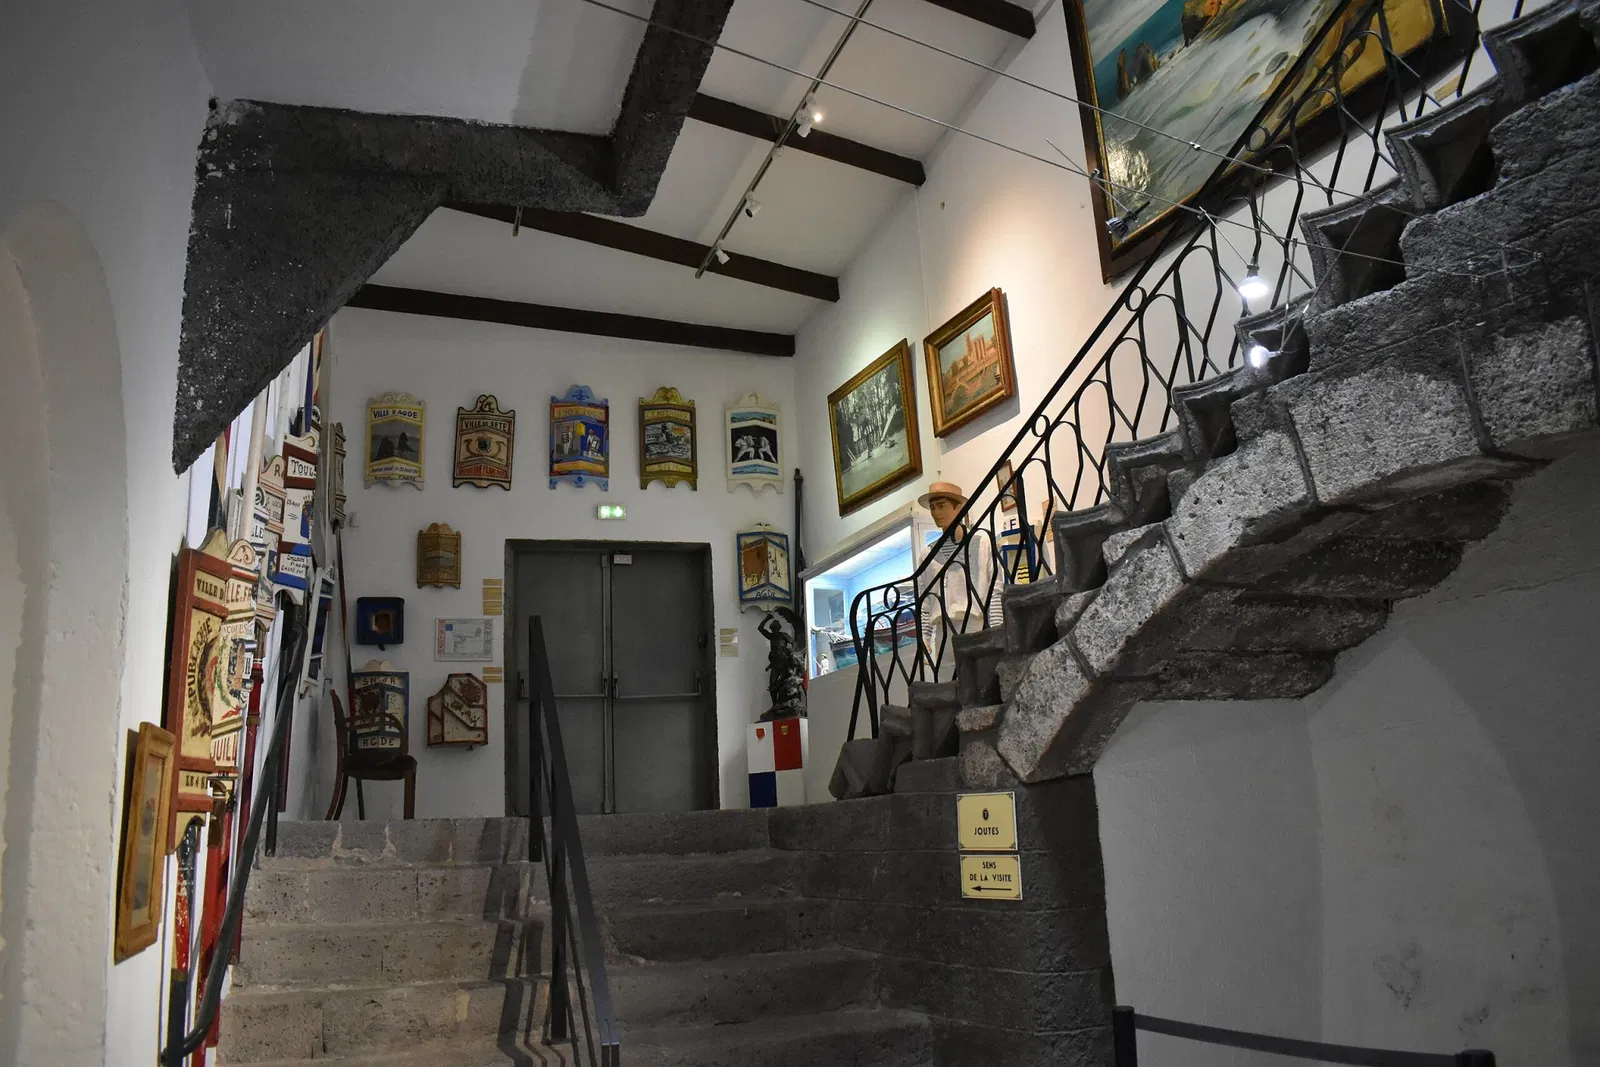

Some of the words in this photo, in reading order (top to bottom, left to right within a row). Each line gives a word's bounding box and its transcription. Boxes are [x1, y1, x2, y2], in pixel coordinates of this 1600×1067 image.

[196, 577, 218, 598] VILLE
[974, 827, 1000, 836] JOUTES
[982, 861, 997, 869] SENS
[969, 873, 977, 881] DE
[980, 873, 989, 881] LA
[992, 873, 1012, 882] VISITE
